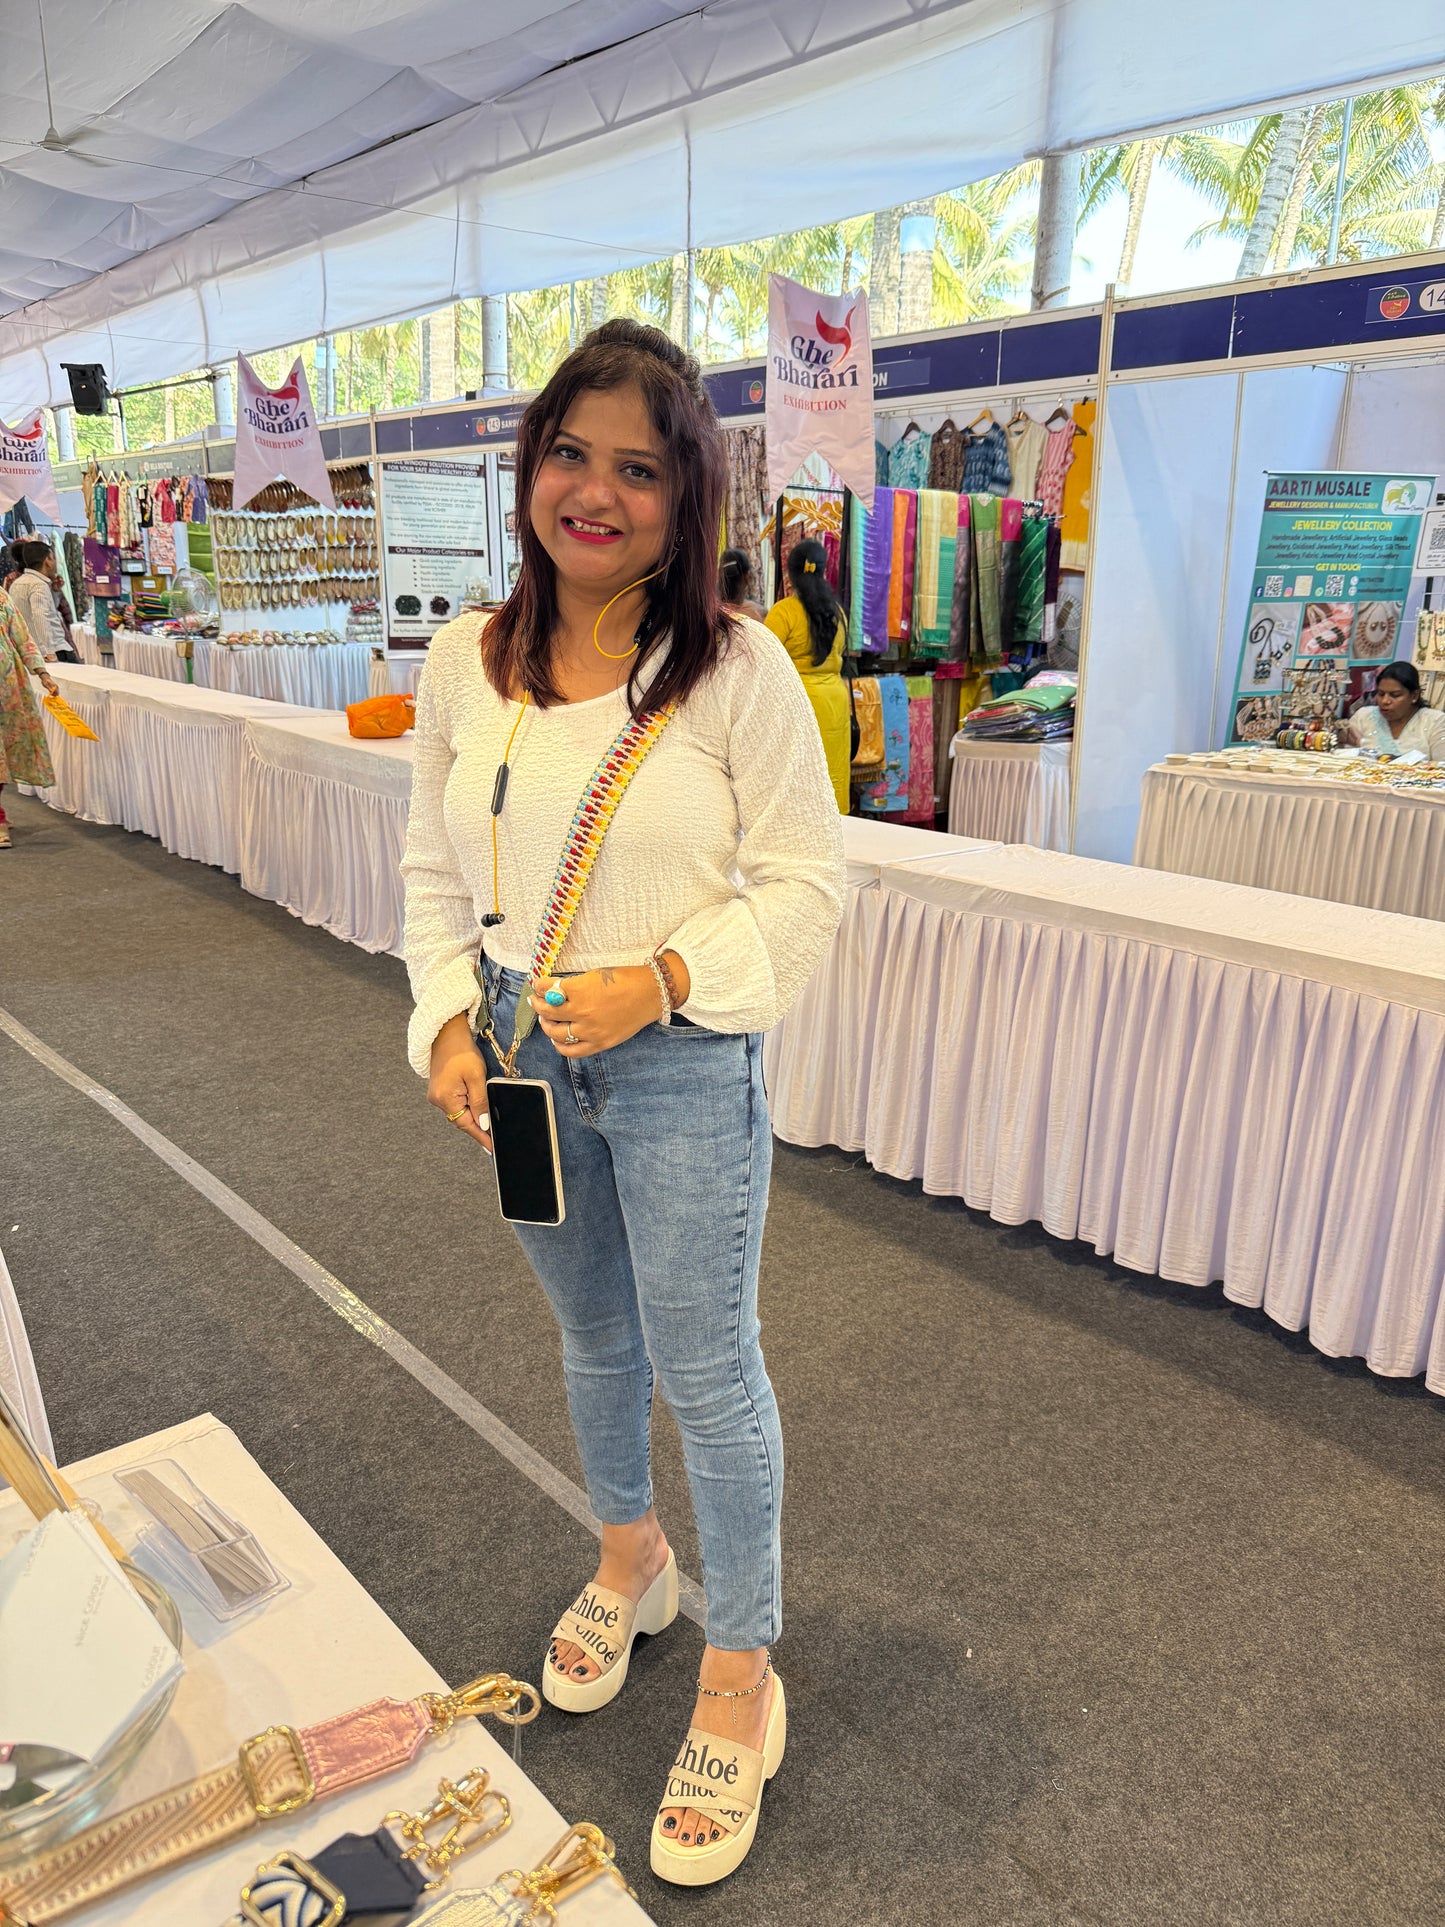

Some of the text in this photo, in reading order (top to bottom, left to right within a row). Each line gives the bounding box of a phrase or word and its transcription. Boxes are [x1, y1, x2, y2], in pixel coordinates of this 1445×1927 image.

[791, 335, 833, 369] Ghe
[773, 356, 859, 389] Bharari
[255, 397, 290, 421] Ghe
[783, 394, 847, 412] EXHIBITION
[244, 408, 309, 434] Bharari
[254, 435, 304, 450] EXHIBITION
[0, 447, 46, 463] harari
[415, 466, 427, 474] SAFE
[440, 468, 462, 476] HEALTHY
[428, 461, 454, 469] SOLUTION
[455, 463, 480, 471] PROVIDER
[1270, 480, 1372, 497] AARTI MUSALE
[1269, 500, 1300, 509] JEWELLERY
[1300, 501, 1329, 509] DESIGNER
[1335, 502, 1378, 510] MANUFACTURER
[1292, 520, 1393, 531] JEWELLERY COLLECTION
[1315, 563, 1329, 571] GET
[1337, 563, 1361, 571] TOUCH
